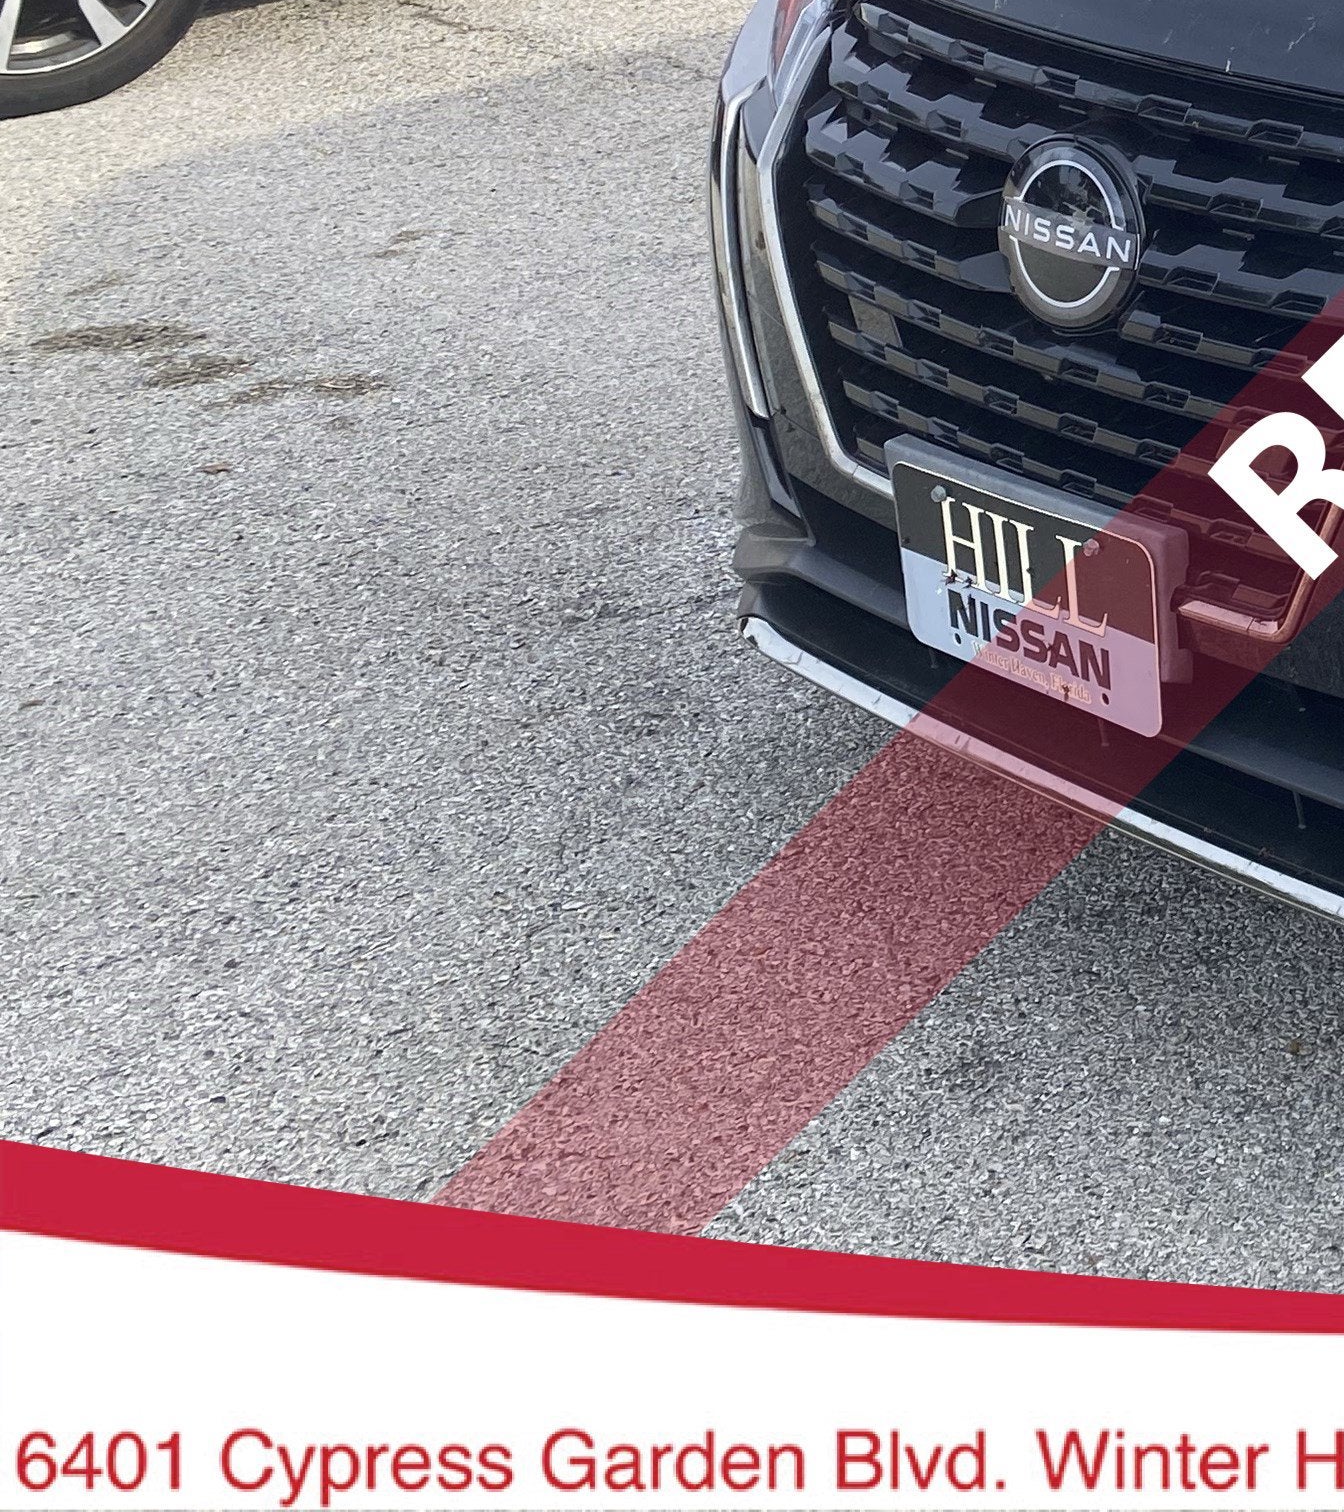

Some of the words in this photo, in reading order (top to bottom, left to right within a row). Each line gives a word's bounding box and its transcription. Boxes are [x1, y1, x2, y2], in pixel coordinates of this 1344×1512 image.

[1004, 204, 1131, 263] NISSAN
[941, 496, 1108, 637] HILL
[946, 588, 1112, 691] NISSAN
